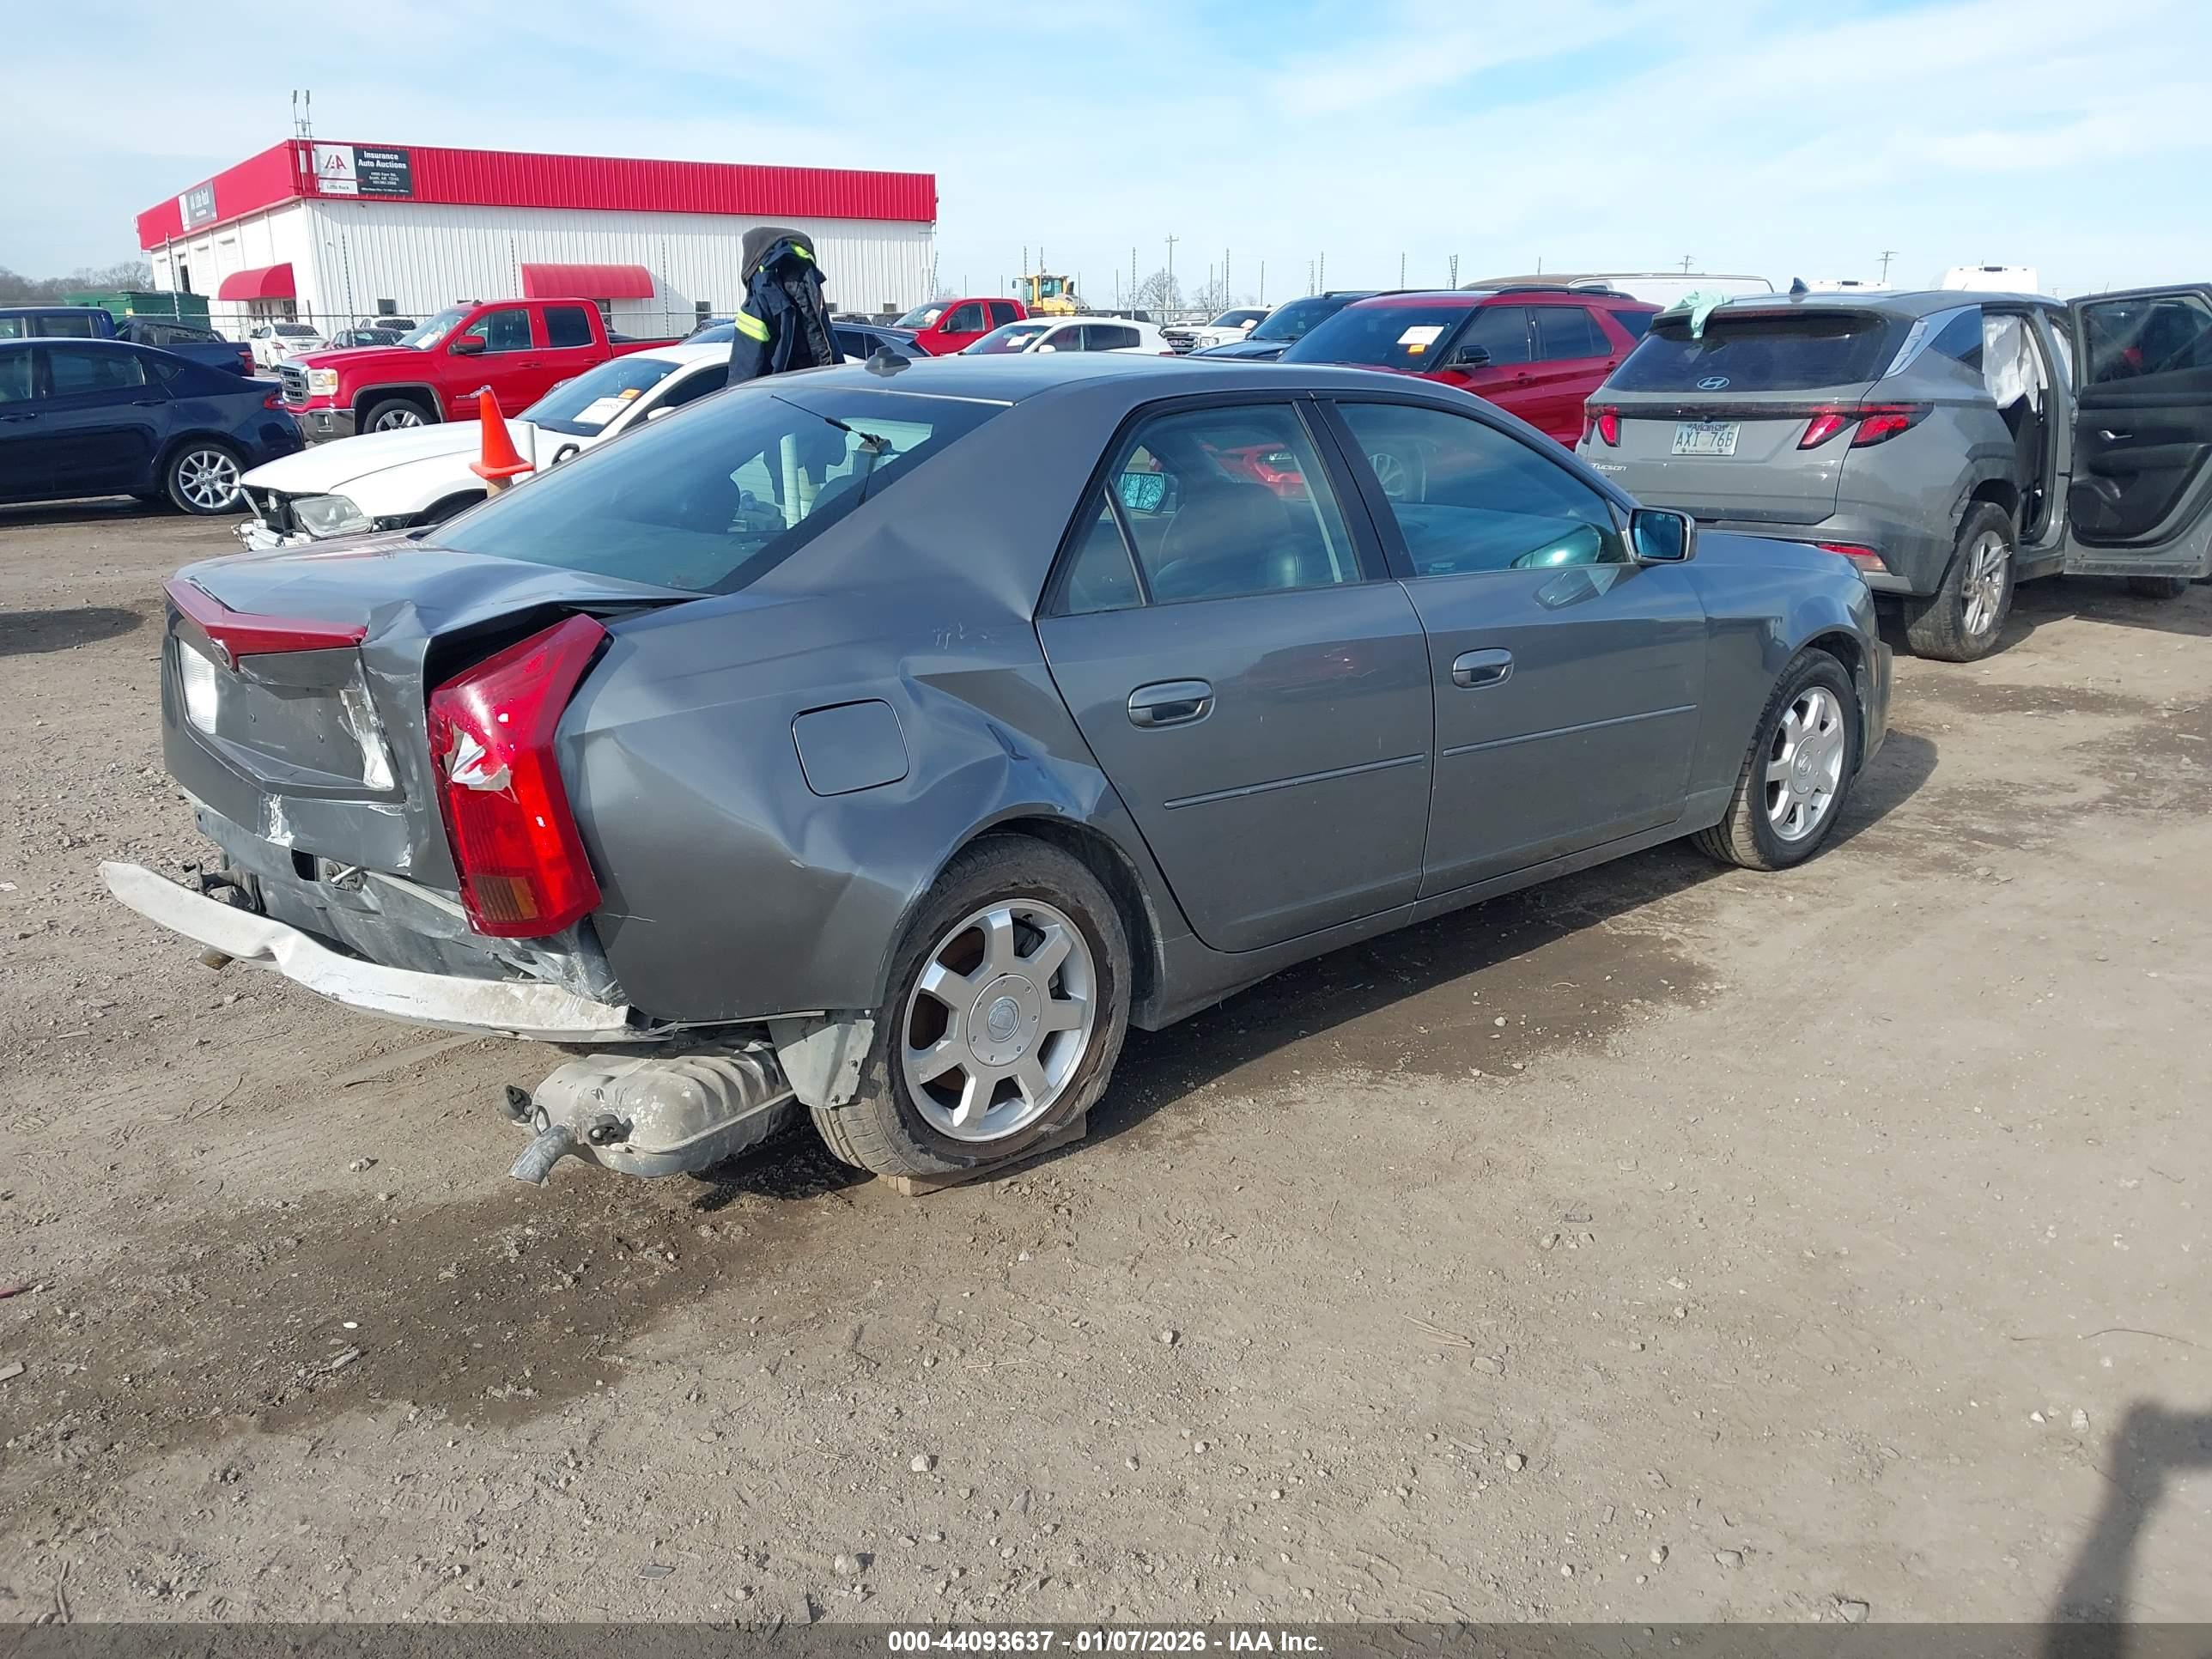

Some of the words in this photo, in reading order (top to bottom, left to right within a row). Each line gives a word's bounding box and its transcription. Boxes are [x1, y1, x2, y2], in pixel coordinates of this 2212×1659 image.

[363, 150, 398, 160] Insurance
[358, 158, 374, 167] Auto
[375, 159, 407, 169] Auctions
[1675, 432, 1700, 447] AXI
[1710, 432, 1734, 447] 76B
